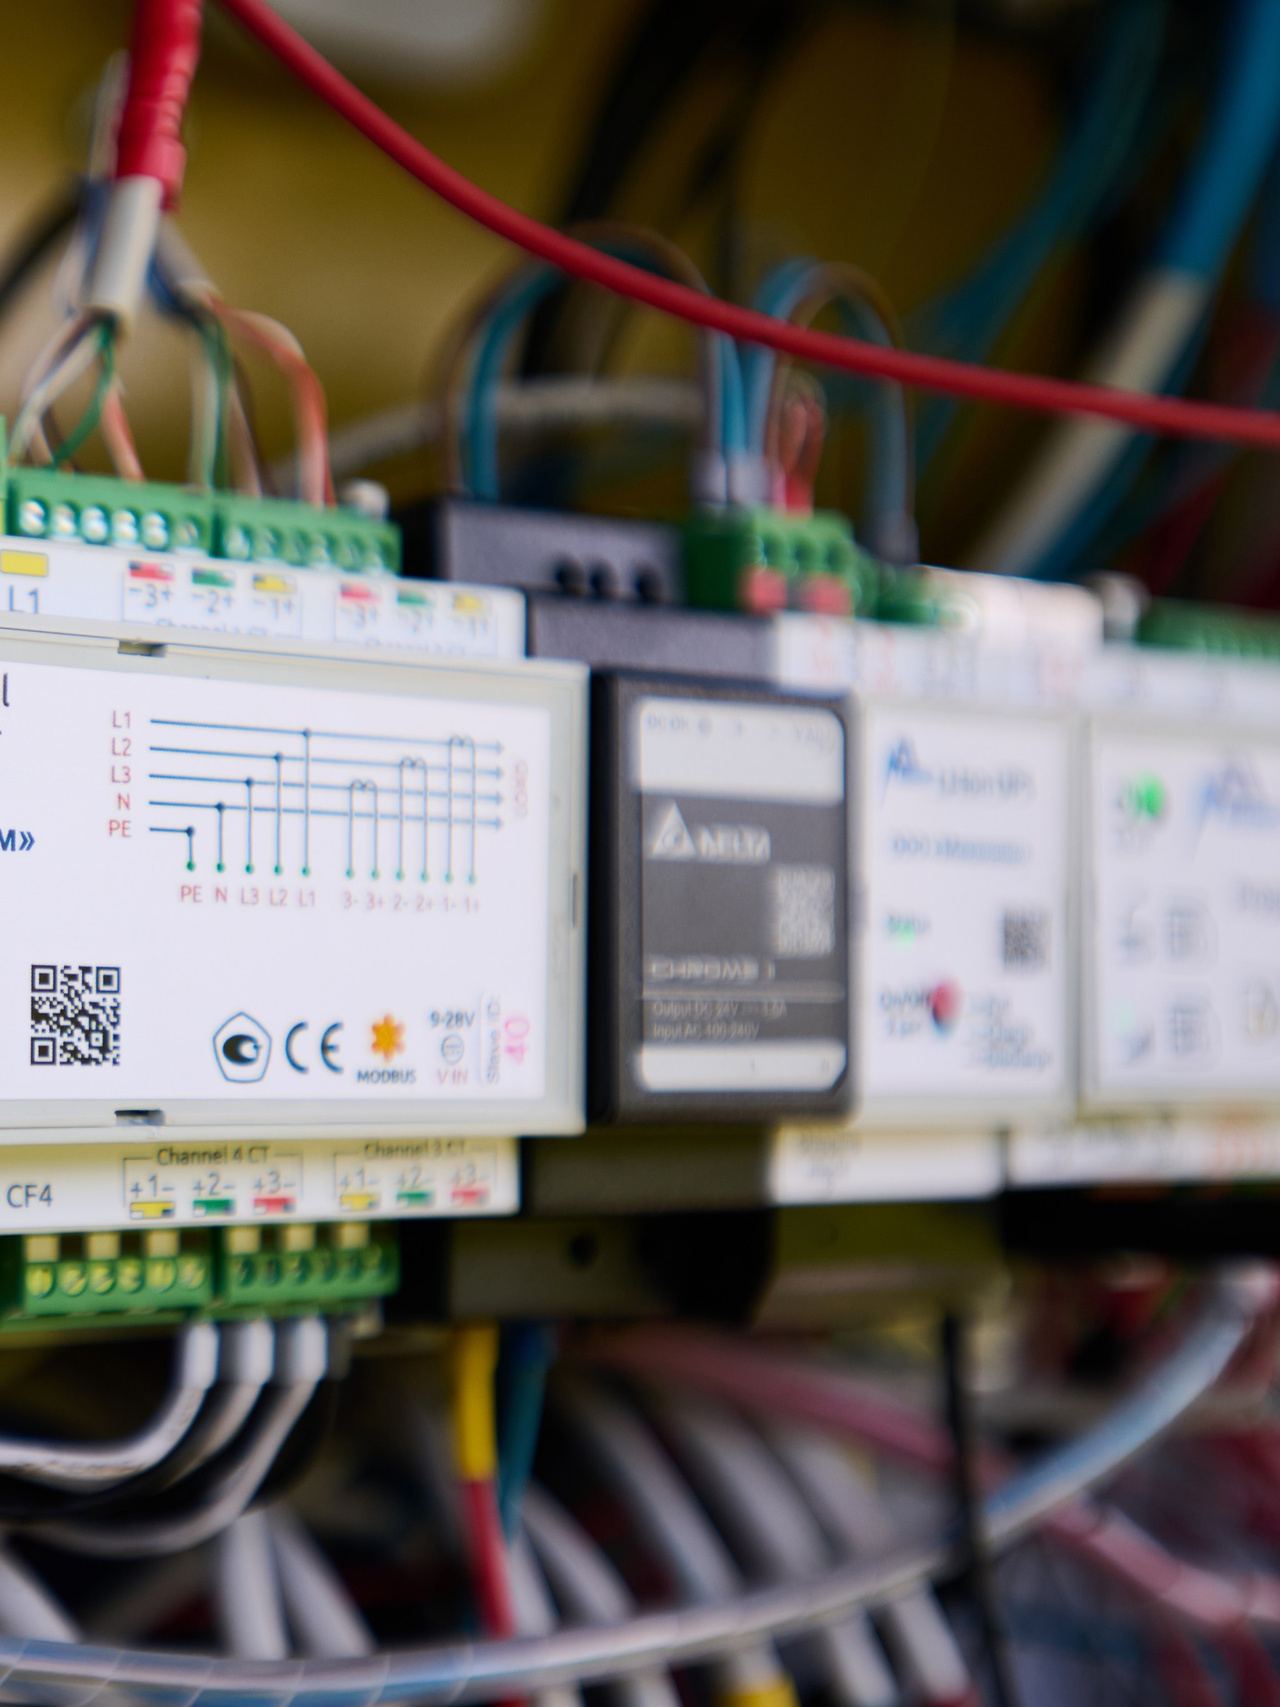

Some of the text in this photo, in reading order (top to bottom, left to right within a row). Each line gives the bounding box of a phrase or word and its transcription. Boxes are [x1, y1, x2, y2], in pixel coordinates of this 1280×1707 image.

[9, 585, 40, 614] L1
[112, 710, 131, 729] L1
[111, 737, 131, 757] L2
[111, 765, 131, 784] L3
[117, 792, 131, 810] N
[109, 819, 132, 838] PE
[180, 885, 202, 903] PE
[215, 886, 228, 904] N
[241, 887, 259, 906] L3
[270, 888, 288, 907] L2
[299, 889, 316, 907] L1
[430, 1011, 475, 1029] 9-28V
[357, 1070, 416, 1085] MODBUS
[157, 1145, 228, 1166] Channel
[248, 1145, 270, 1164] CT
[7, 1183, 53, 1209] CF4
